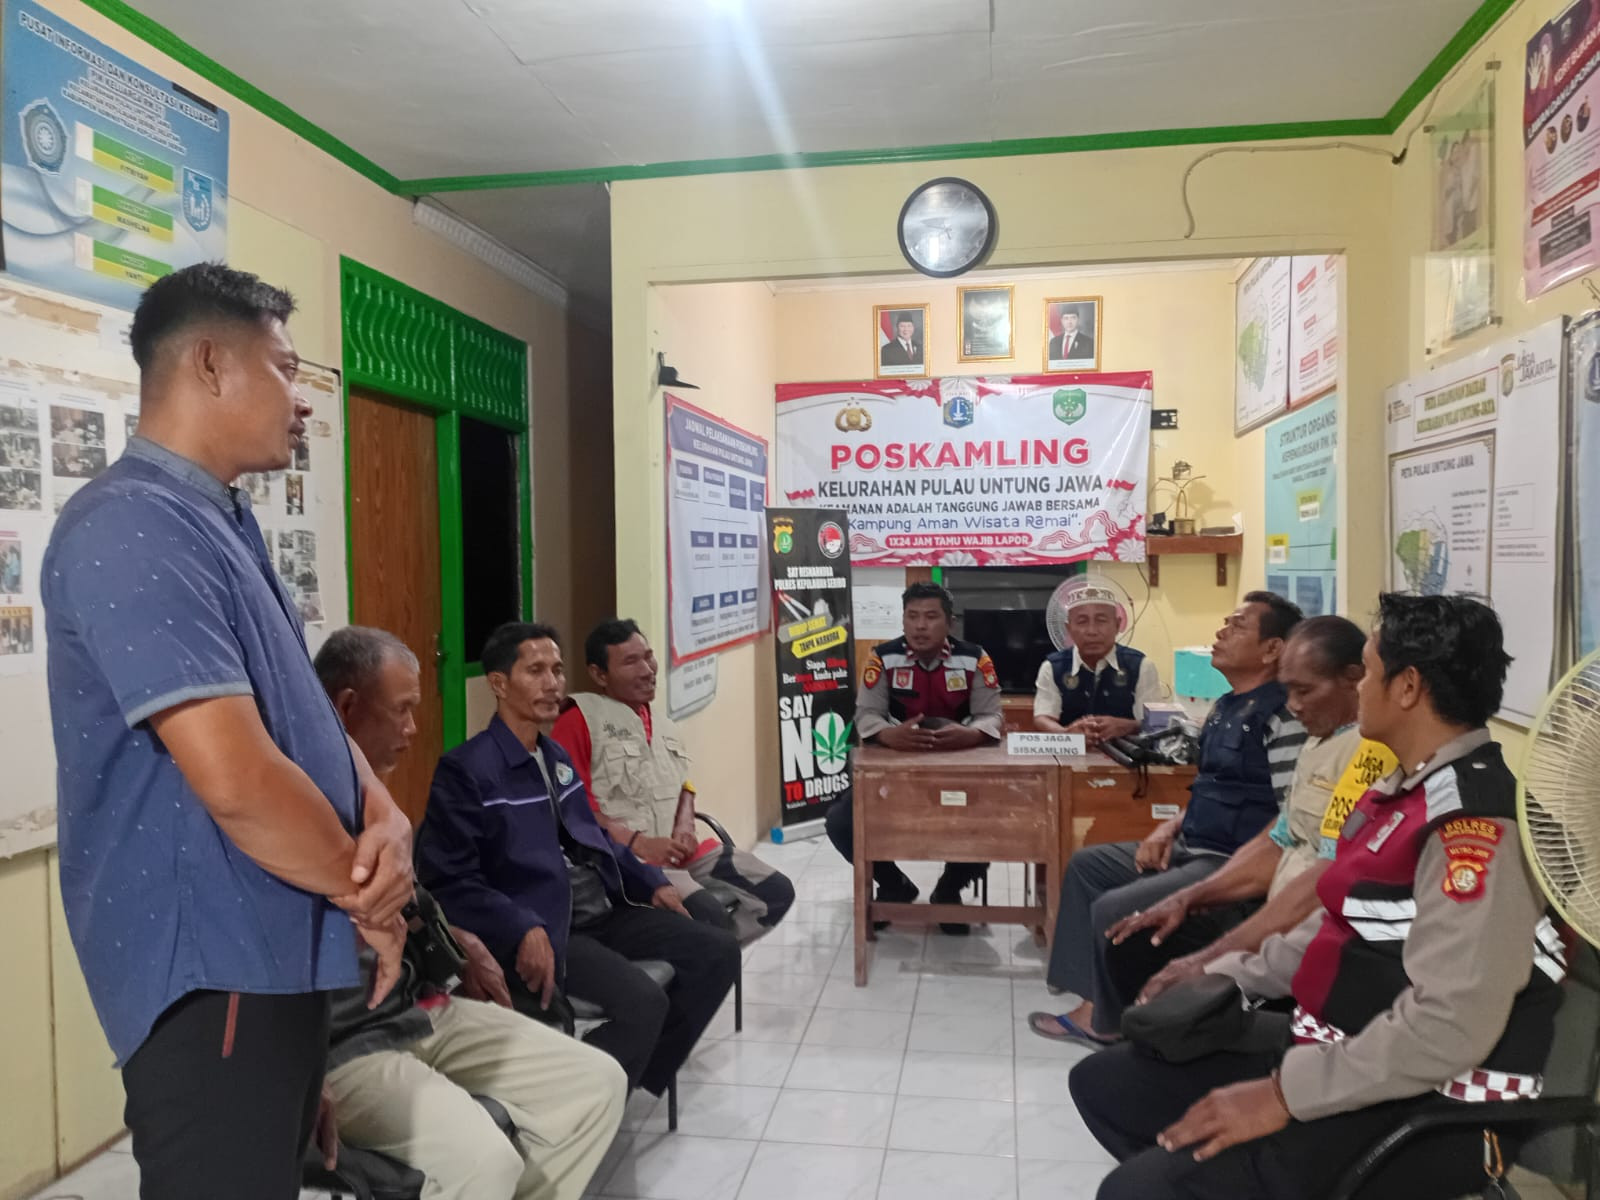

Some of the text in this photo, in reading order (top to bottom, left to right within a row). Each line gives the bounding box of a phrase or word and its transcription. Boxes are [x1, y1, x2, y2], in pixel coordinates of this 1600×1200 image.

[19, 11, 54, 43] PUSAT
[53, 32, 105, 72] INFORMASI
[106, 61, 126, 81] DAN
[126, 71, 178, 110] KONSULTASI
[831, 438, 1090, 471] POSKAMLING
[818, 475, 1103, 498] KELURAHAN PULAU UNTUNG JAWA
[886, 502, 932, 514] ADALAH
[935, 500, 999, 514] TANGGUNG
[1002, 500, 1042, 512] JAWAB
[1046, 497, 1100, 511] BERSAMA
[917, 517, 958, 529] Aman
[964, 516, 1020, 529] Wisata
[912, 537, 933, 546] JAM
[934, 537, 961, 546] TAMU
[963, 536, 994, 545] WAJIB
[998, 536, 1029, 546] LAPOR
[780, 694, 813, 719] SAY
[781, 711, 847, 783] NO
[1019, 734, 1041, 742] POS
[1013, 746, 1079, 755] SISKAMLING
[784, 773, 849, 803] TO DRUGS
[1444, 819, 1497, 834] POLRES
